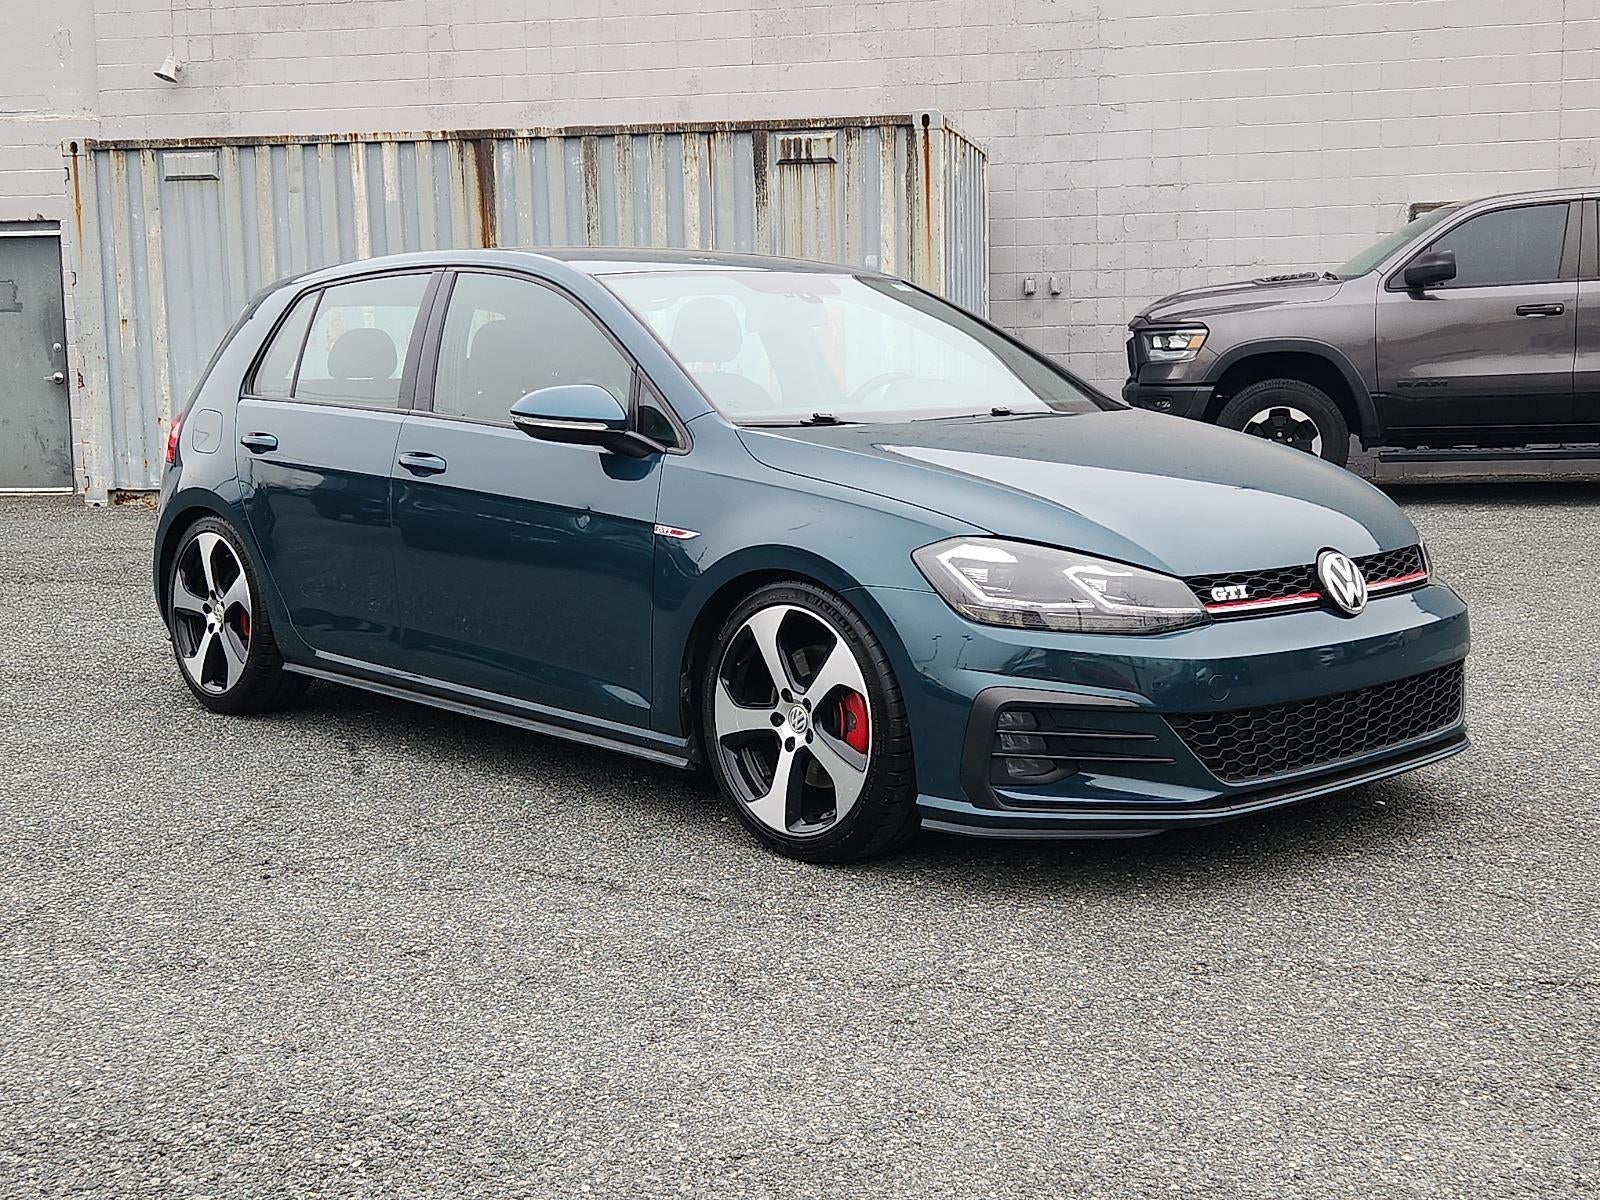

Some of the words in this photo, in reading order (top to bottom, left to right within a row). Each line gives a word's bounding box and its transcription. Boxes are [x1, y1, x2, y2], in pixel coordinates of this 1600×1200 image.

[1396, 379, 1448, 388] RAM
[1319, 550, 1368, 614] VW
[1211, 584, 1249, 602] GTI
